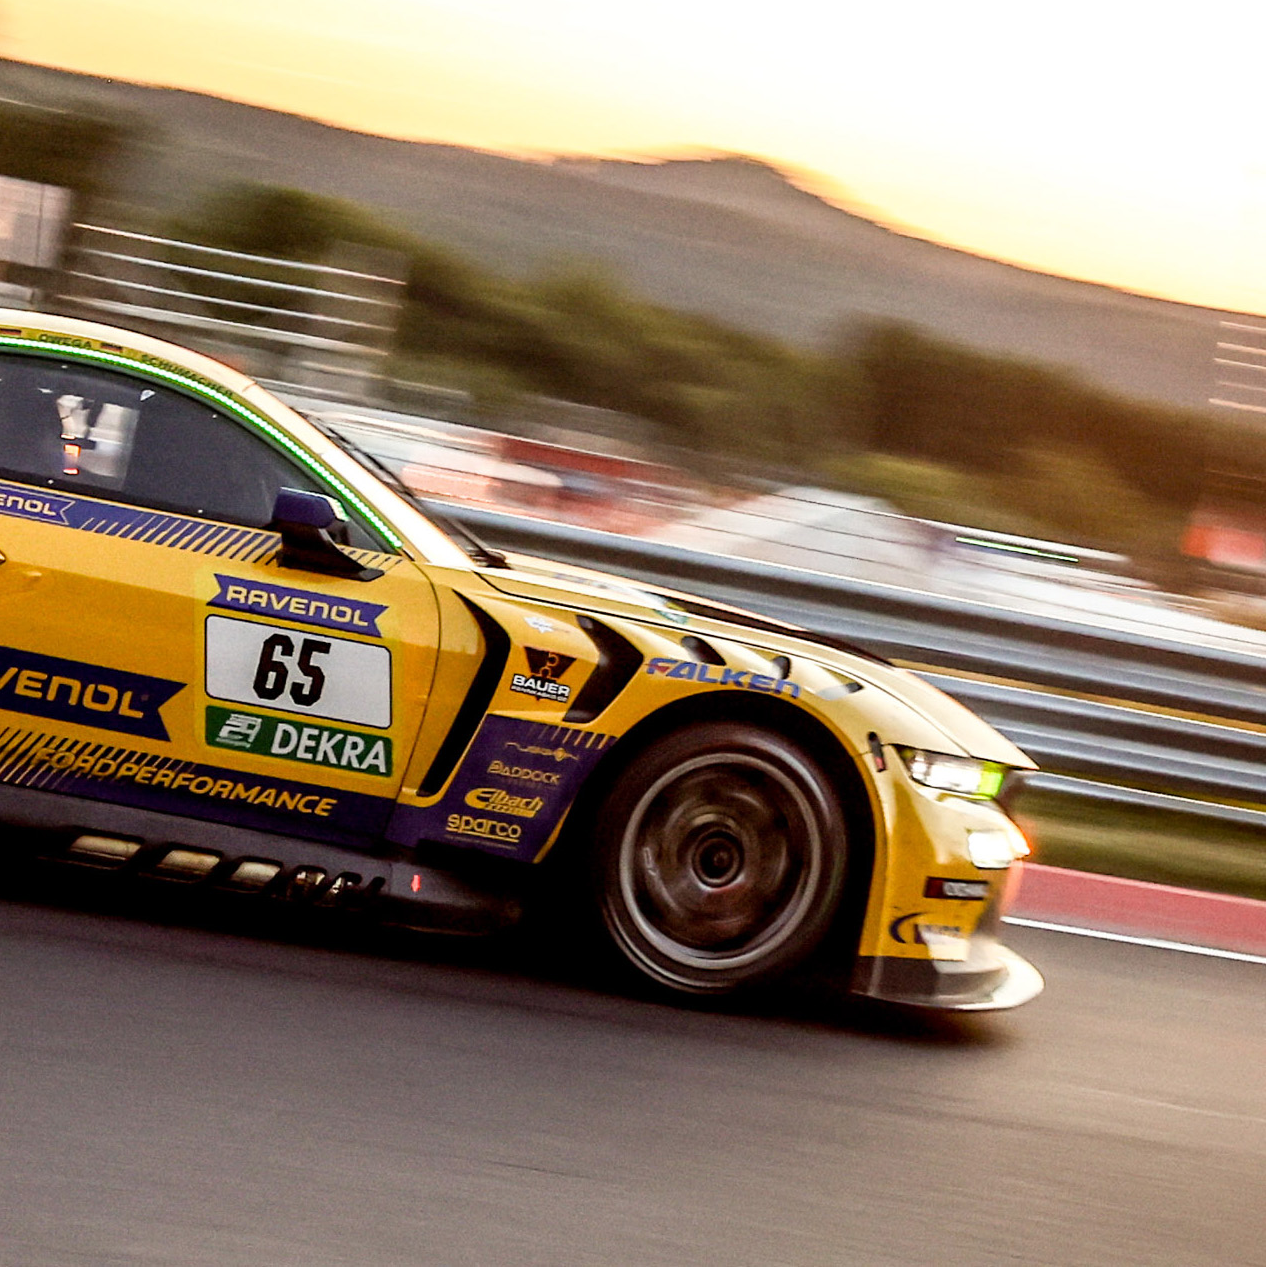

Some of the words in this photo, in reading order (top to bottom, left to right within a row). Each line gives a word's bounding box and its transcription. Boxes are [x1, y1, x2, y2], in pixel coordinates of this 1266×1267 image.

[225, 584, 371, 627] RAVENOL
[253, 633, 332, 708] 65
[513, 675, 571, 697] BAUER
[646, 657, 801, 699] FALKEN
[270, 722, 387, 774] DEKRA
[447, 814, 522, 838] sparco
